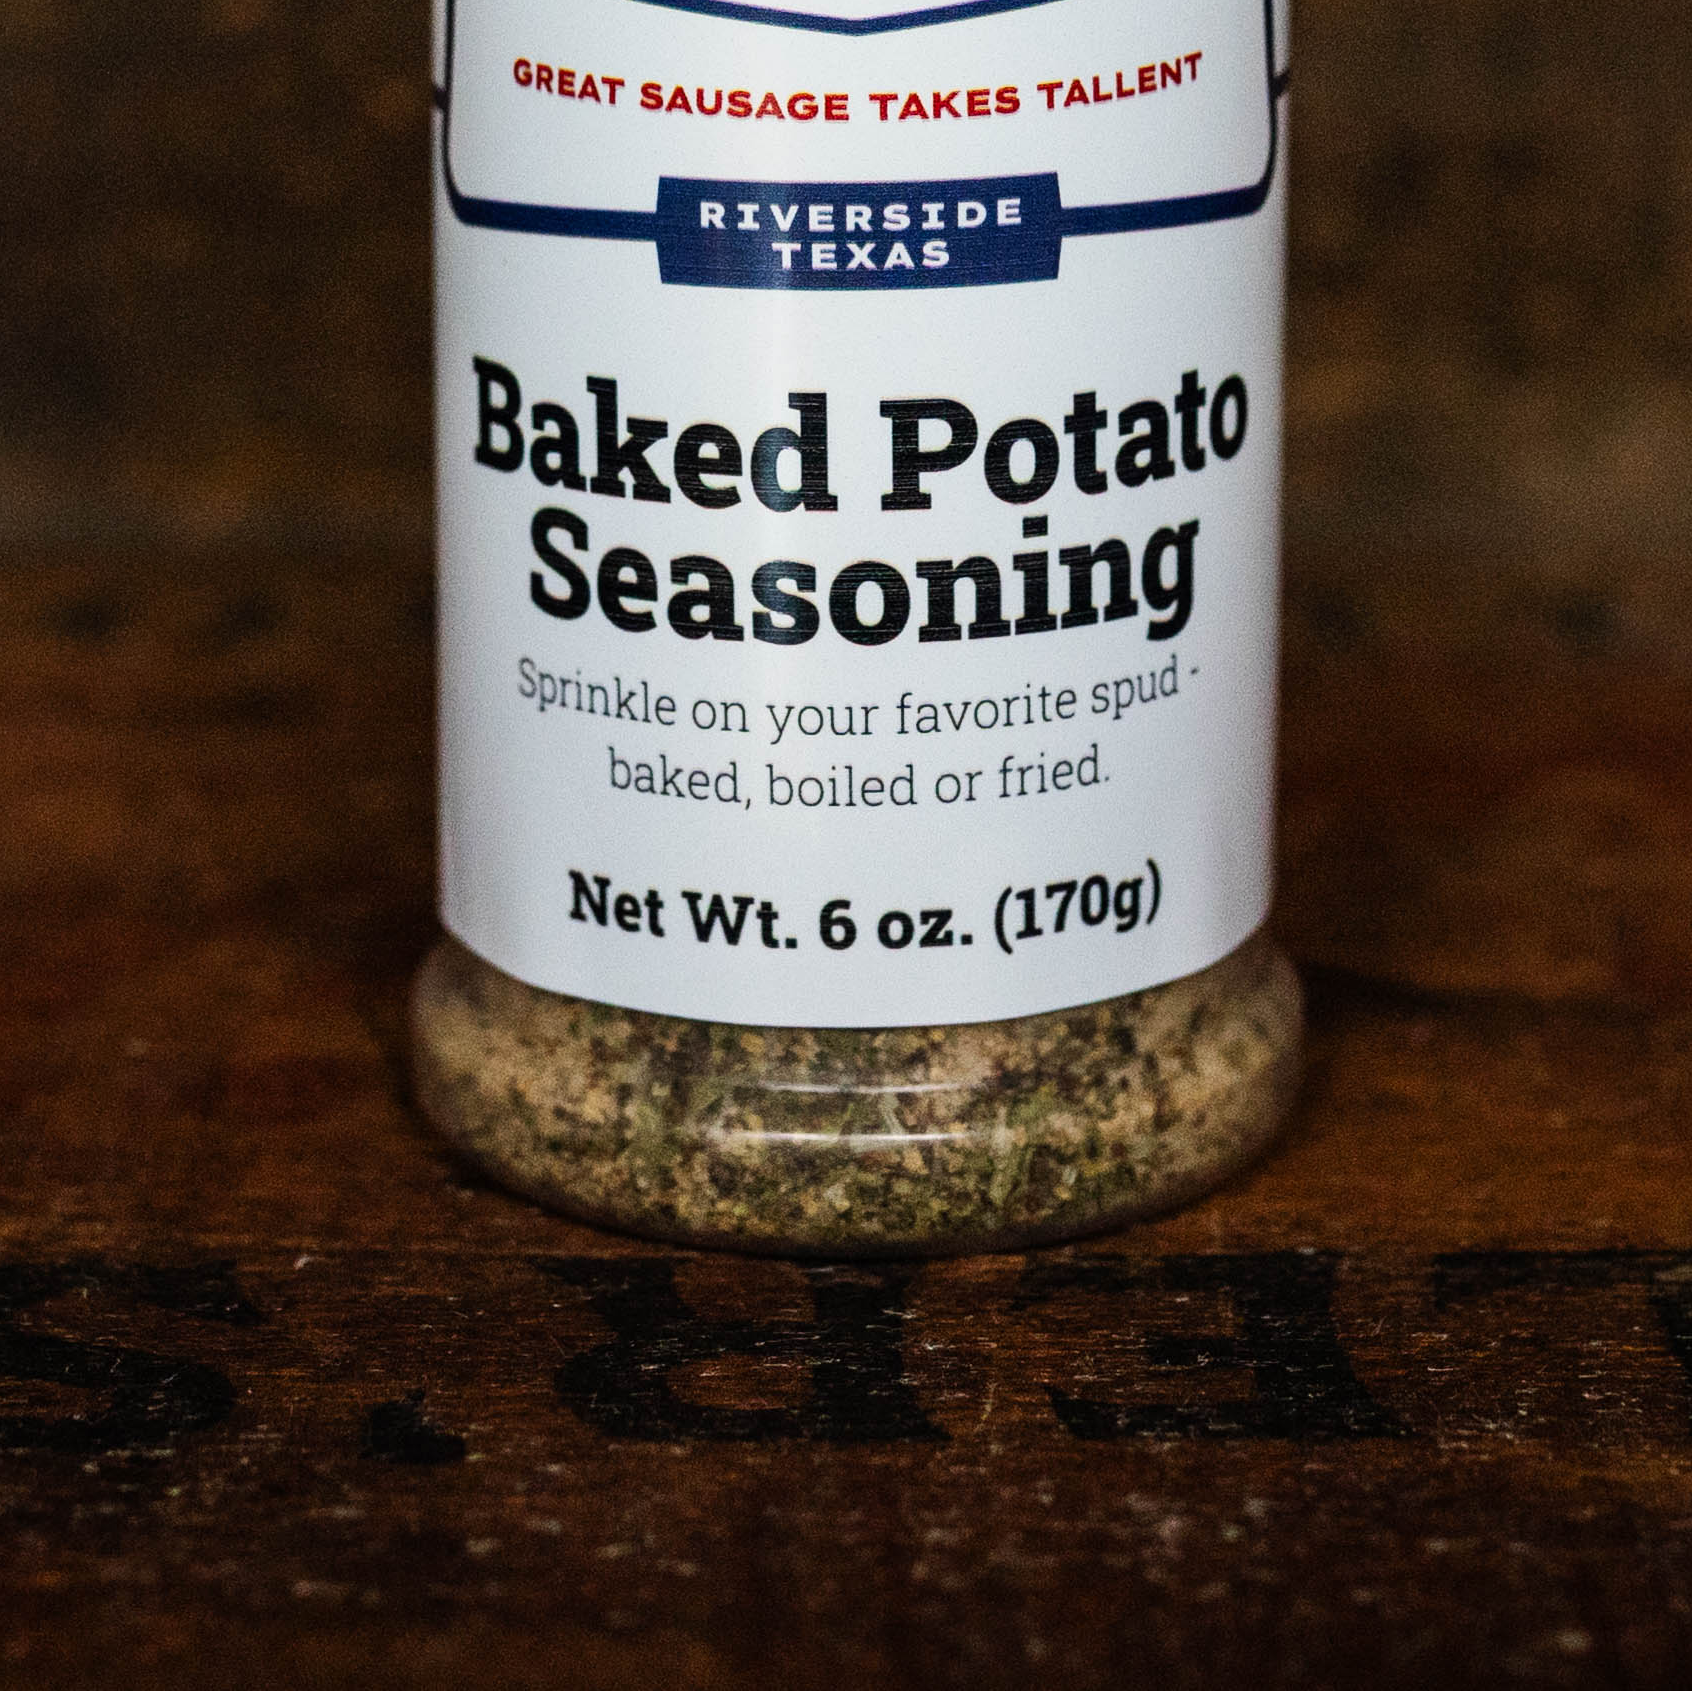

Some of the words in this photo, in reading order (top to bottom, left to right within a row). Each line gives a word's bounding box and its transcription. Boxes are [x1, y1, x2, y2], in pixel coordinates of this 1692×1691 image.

[514, 58, 624, 104] GREAT
[640, 82, 849, 121] SAUSAGE
[869, 86, 1020, 121] TAKES
[1037, 51, 1202, 109] TALLENT
[701, 198, 1021, 231] RIVERSIDE
[771, 240, 949, 270] TEXAS
[472, 354, 838, 513] Baked
[880, 369, 1249, 511] Potato
[530, 505, 1200, 646] Seasoning
[519, 657, 676, 726] Sprinkle
[692, 699, 749, 733] on
[766, 705, 879, 745] your
[897, 686, 1077, 735] favorite
[1091, 653, 1179, 720] spud
[608, 746, 751, 810] baked,
[766, 763, 917, 807] boiled
[935, 771, 982, 804] or
[999, 743, 1112, 798] fried.
[569, 870, 664, 937] Net
[681, 891, 797, 949] Wt.
[820, 899, 857, 950] 6
[877, 909, 973, 949] oz.
[995, 858, 1161, 954] (170g)
